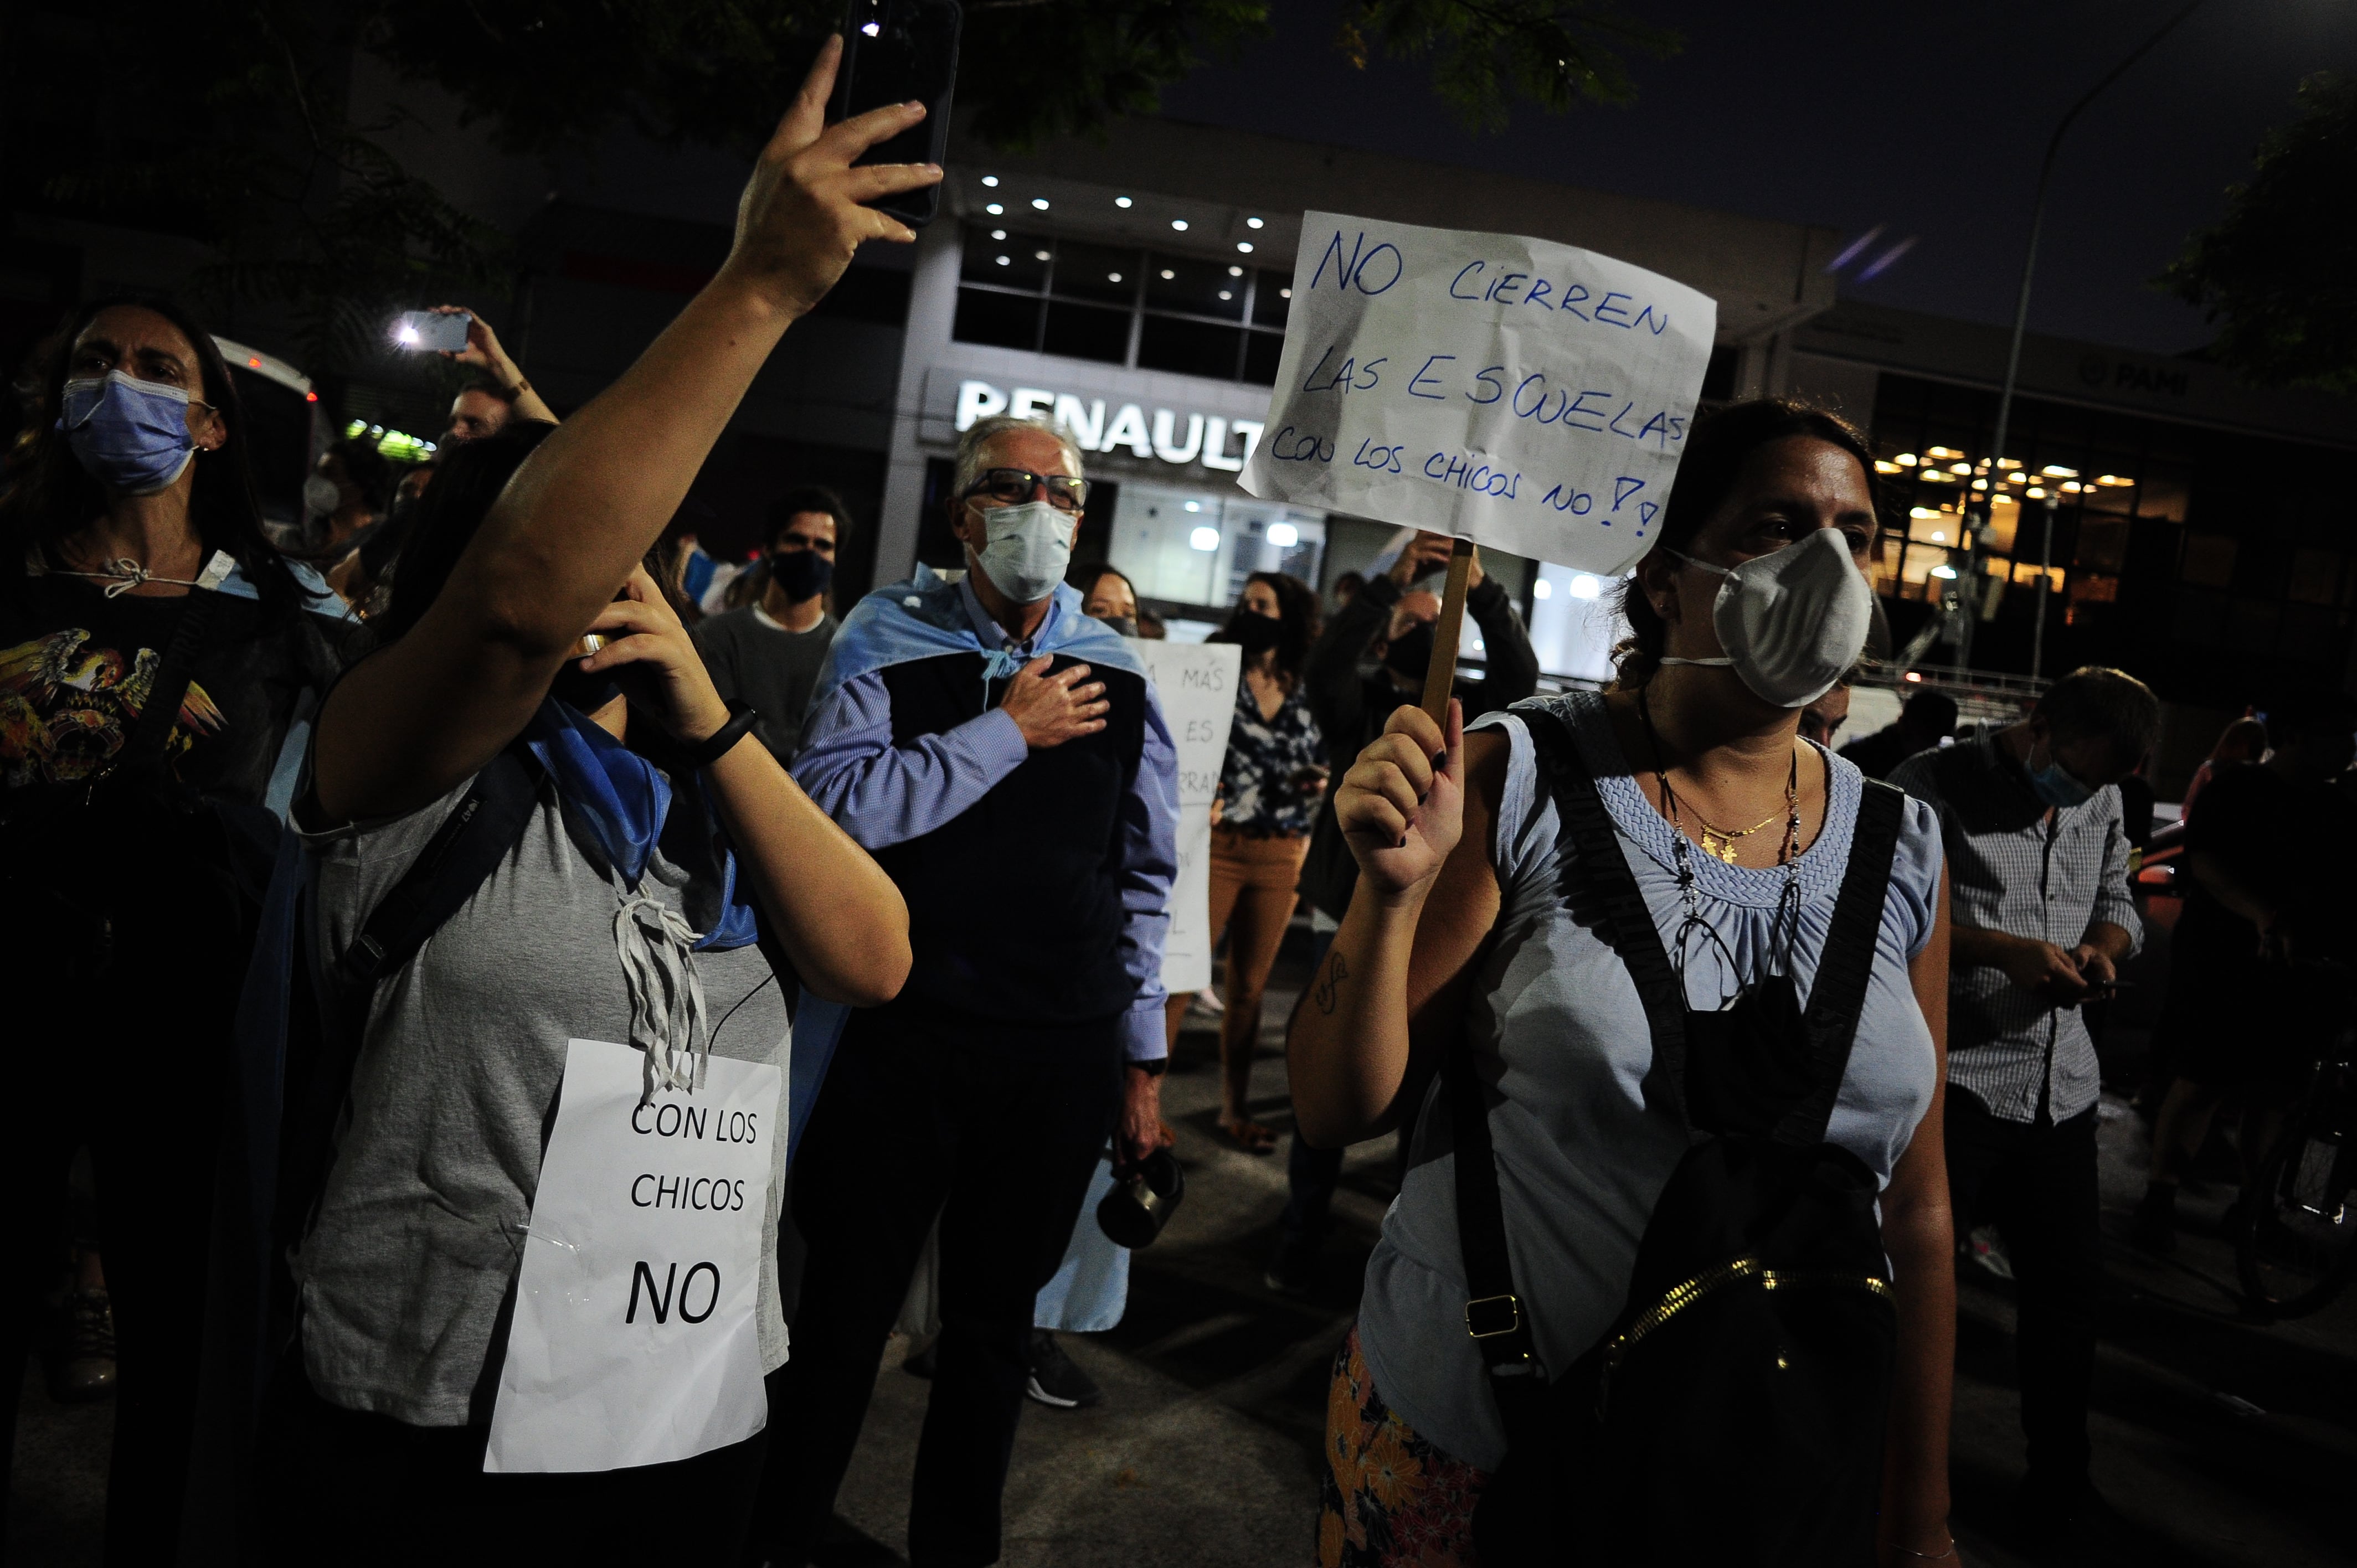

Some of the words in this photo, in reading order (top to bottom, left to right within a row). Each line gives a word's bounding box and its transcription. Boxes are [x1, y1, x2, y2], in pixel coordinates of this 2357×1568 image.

[1311, 230, 1402, 295] NO
[1303, 346, 1387, 394] LAS
[1408, 355, 1685, 450] ESCUELAS
[2117, 363, 2189, 396] PAMI
[955, 380, 1265, 472] RENAULT
[1272, 427, 1335, 463] CON
[1354, 438, 1405, 473] LOS
[1182, 659, 1224, 692] MÁS
[1185, 720, 1214, 743] ES
[1559, 780, 1633, 894] JACKIE
[1604, 893, 1680, 1007] SMITH
[631, 1102, 707, 1139] CON
[716, 1110, 757, 1144] LOS
[631, 1173, 745, 1211] CHICOS
[626, 1261, 721, 1324] NO
